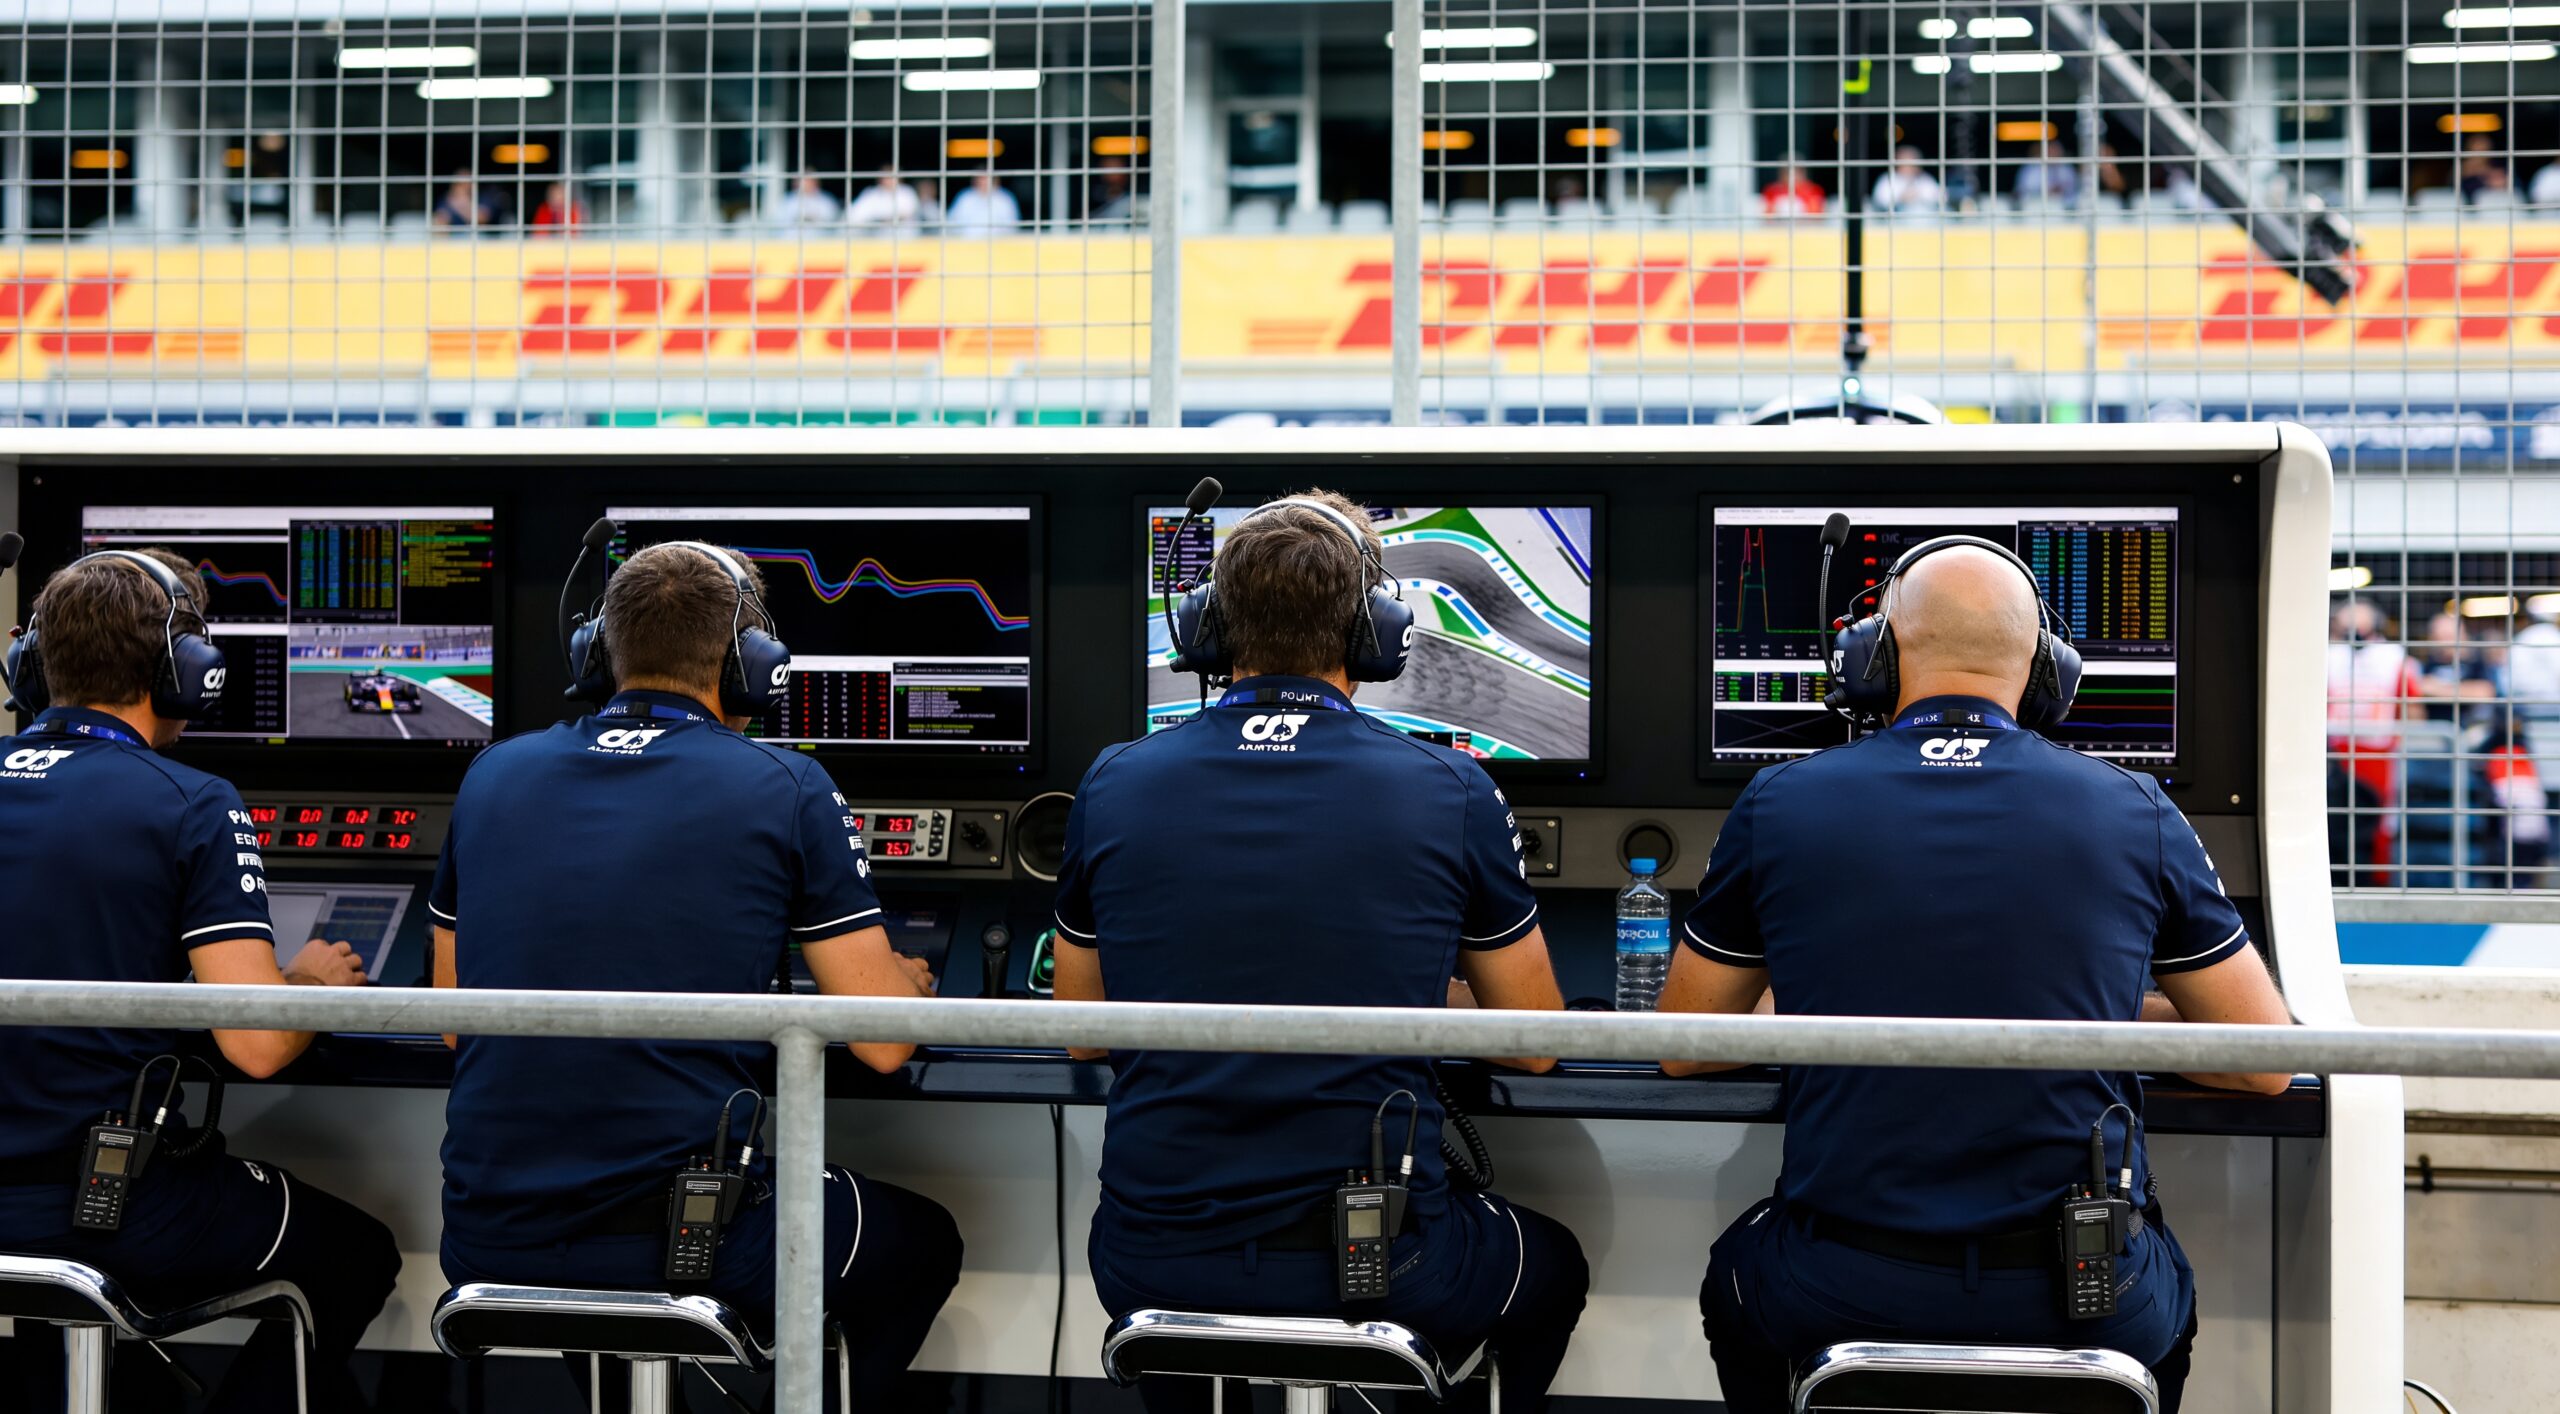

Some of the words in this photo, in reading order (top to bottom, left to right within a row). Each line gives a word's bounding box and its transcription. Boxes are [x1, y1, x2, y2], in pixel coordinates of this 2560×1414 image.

[518, 267, 950, 353] DHL
[1336, 258, 1791, 346] DHL
[2200, 250, 2560, 341] DH
